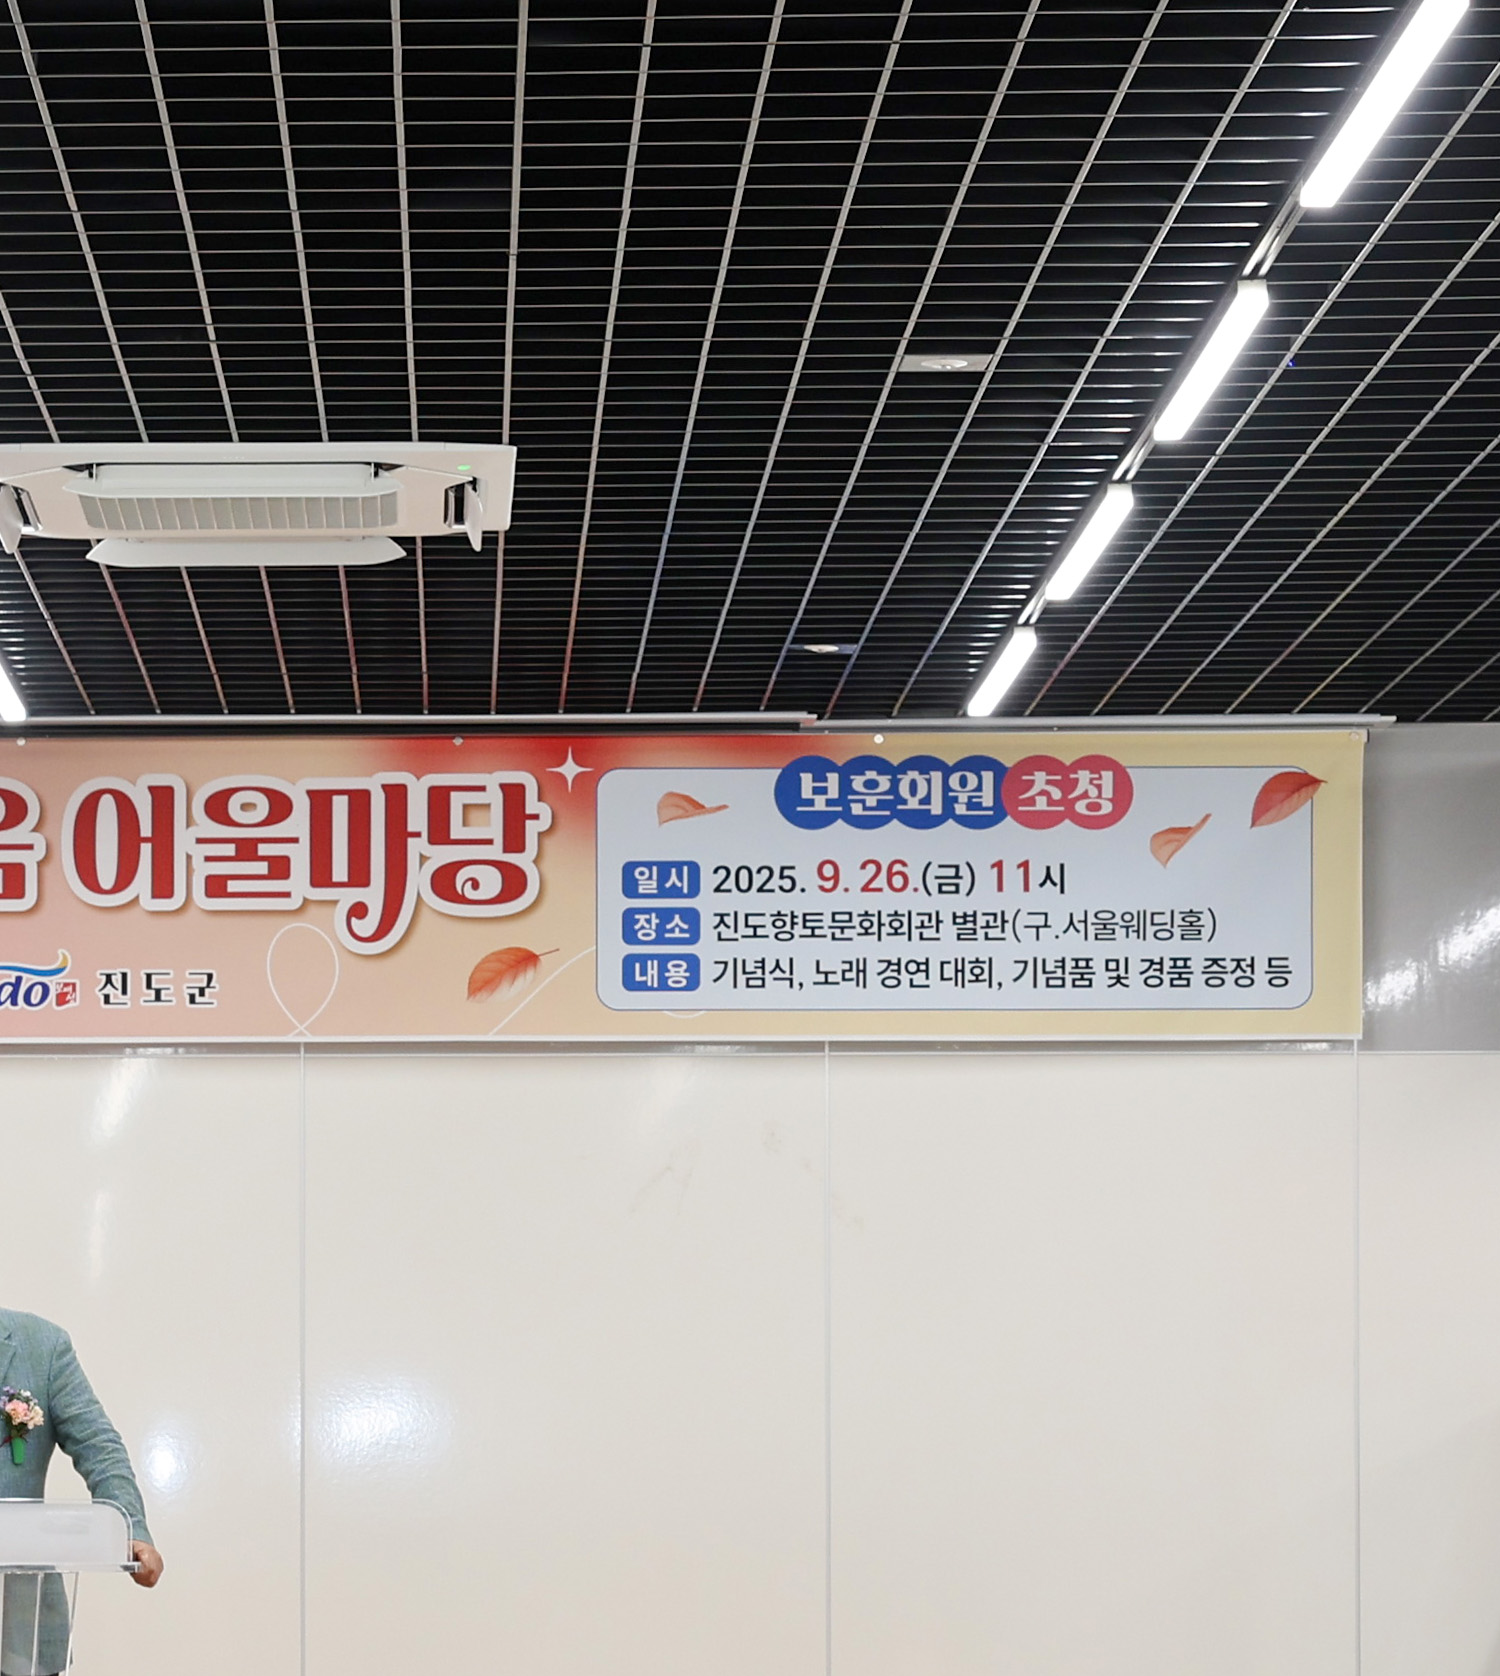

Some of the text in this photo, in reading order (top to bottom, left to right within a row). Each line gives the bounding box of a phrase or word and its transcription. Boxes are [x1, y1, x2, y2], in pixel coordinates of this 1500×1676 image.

[797, 771, 1115, 817] 보훈회원 초청
[74, 785, 541, 944] 어울마당
[712, 865, 806, 894] 2025.
[816, 859, 850, 893] 9.
[990, 859, 1066, 895] 11시
[712, 910, 943, 942] 진도향토문화회관
[952, 907, 1217, 943] 별관(구.서울웨딩홀)
[712, 957, 804, 991] 기념식,
[813, 957, 867, 989] 노래
[876, 957, 930, 989] 경연
[940, 956, 1003, 991] 대회,
[1012, 956, 1096, 989] 기념품
[1105, 956, 1130, 989] 및
[1139, 956, 1193, 989] 경품
[1201, 956, 1255, 989] 증정
[1265, 956, 1292, 989] 등
